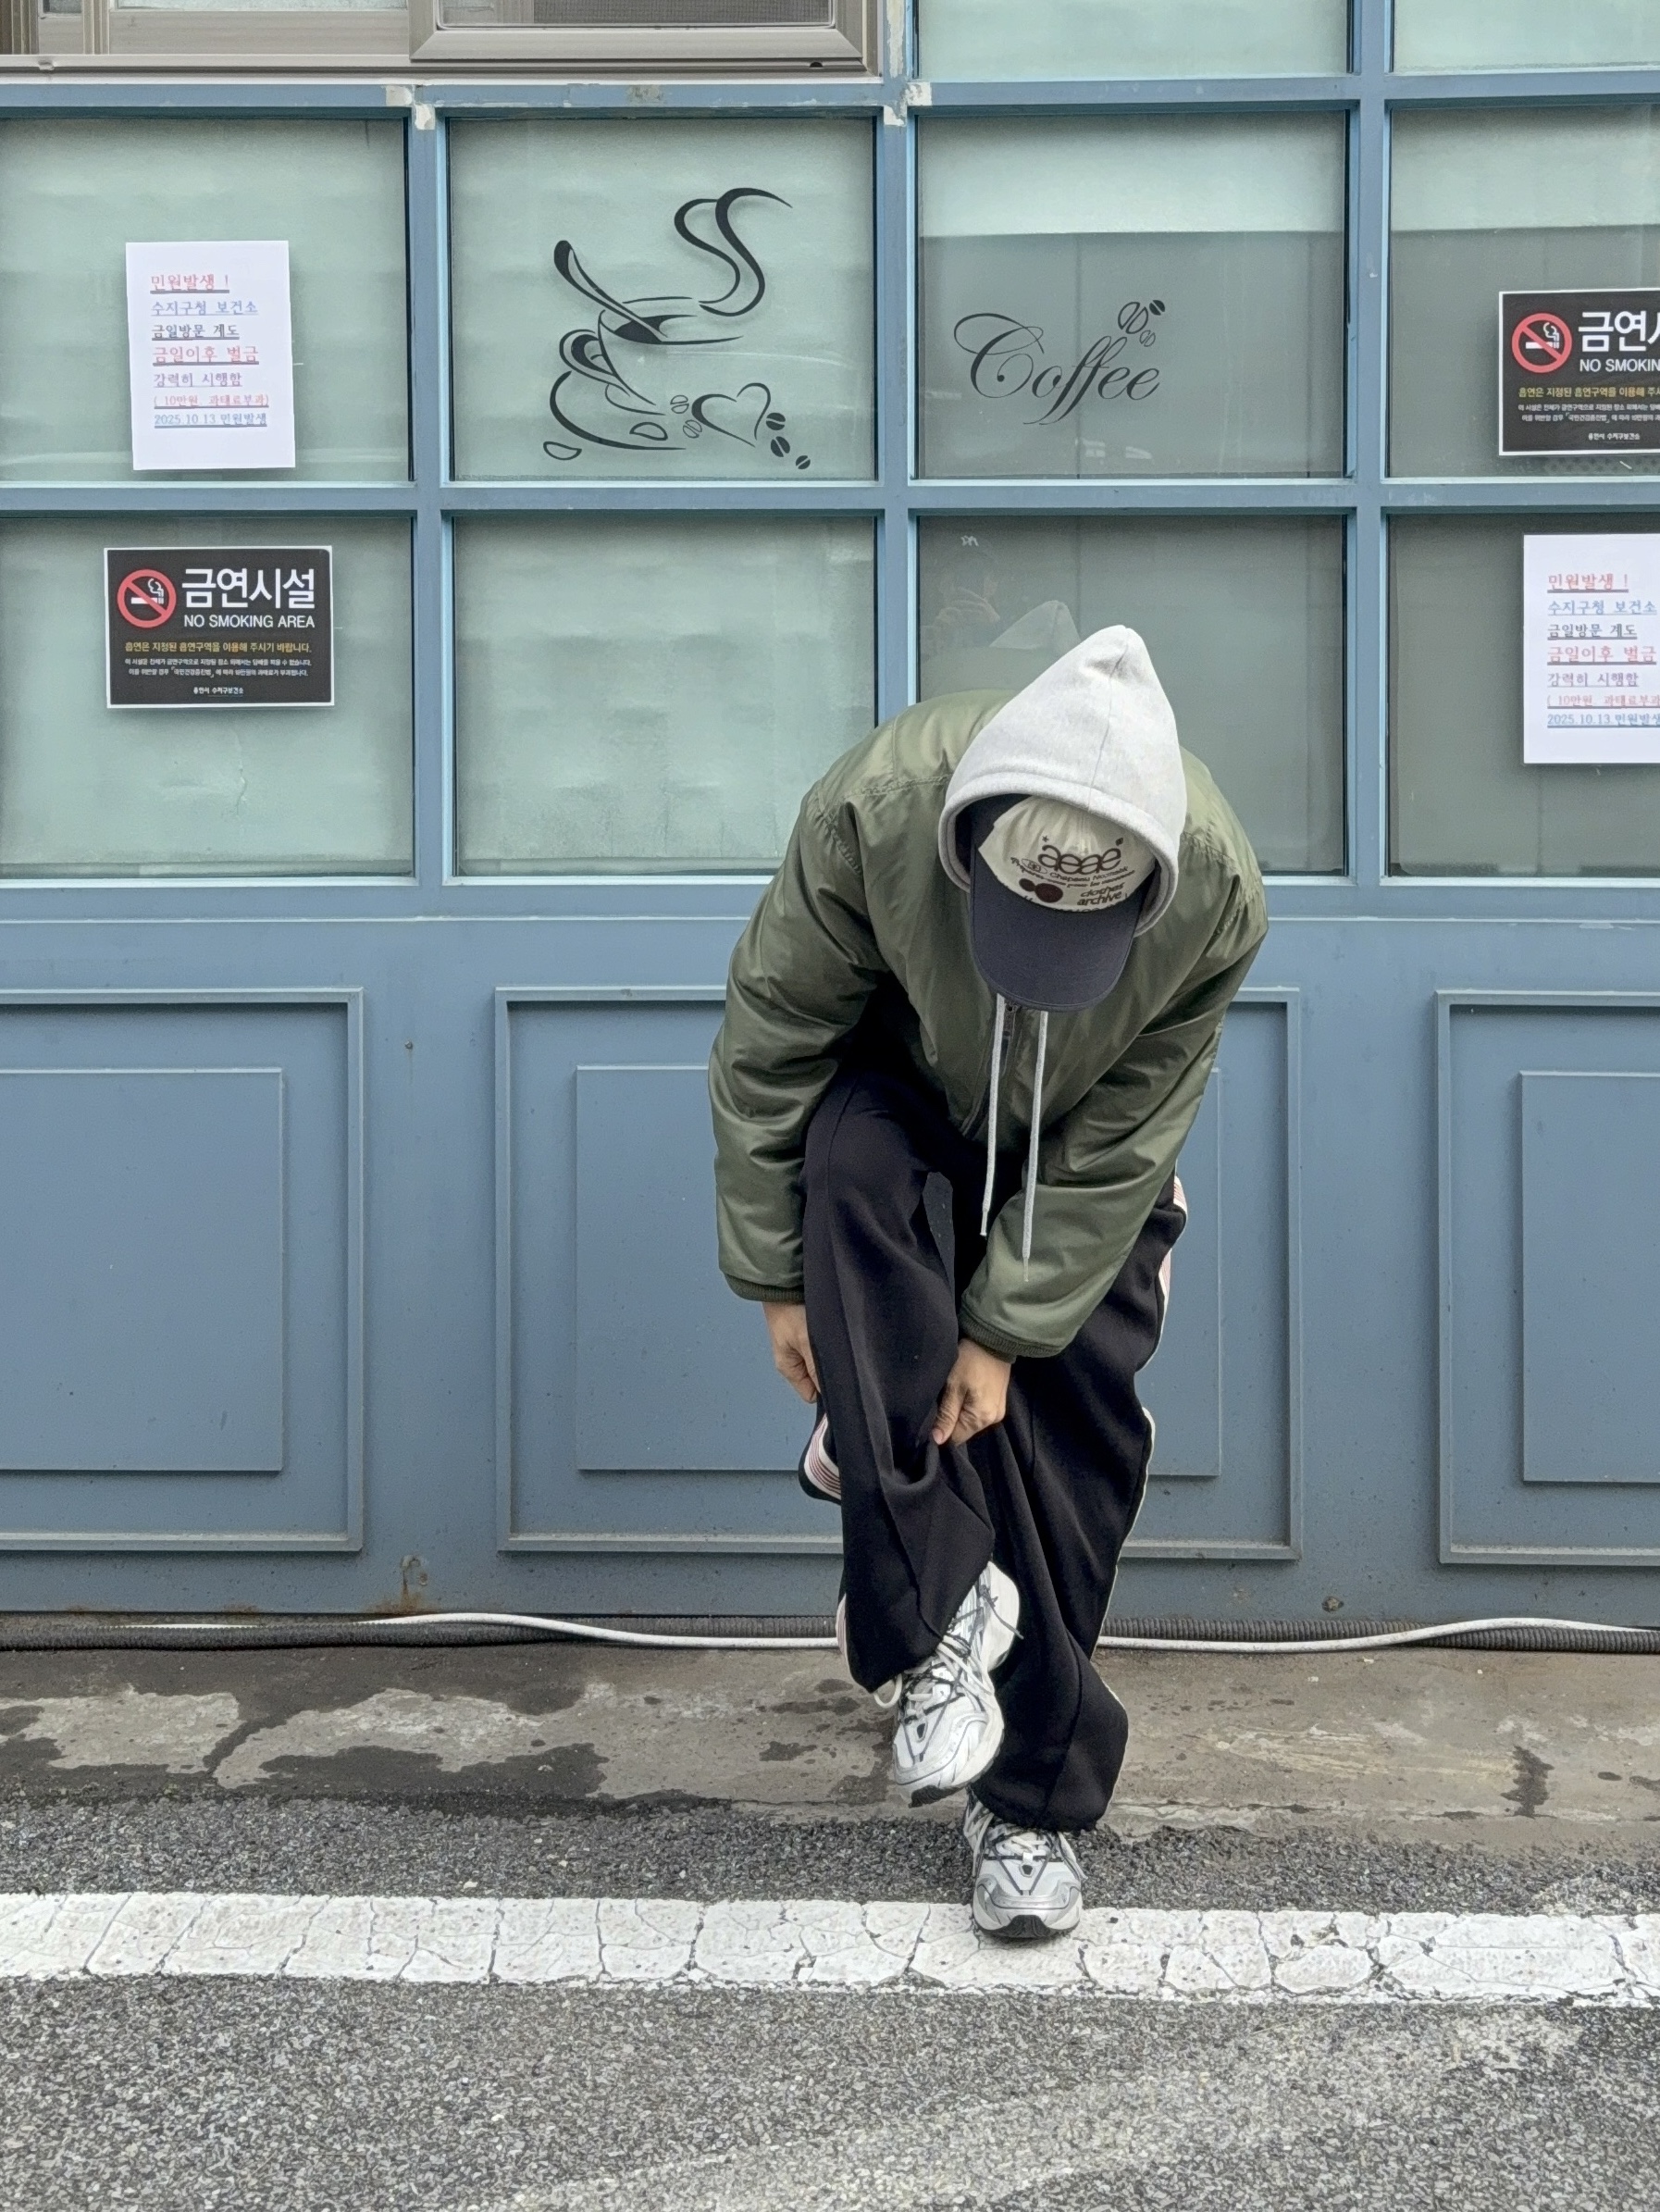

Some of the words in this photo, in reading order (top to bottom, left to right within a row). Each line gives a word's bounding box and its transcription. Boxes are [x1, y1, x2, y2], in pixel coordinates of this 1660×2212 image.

[151, 274, 215, 292] 민원발생
[151, 301, 207, 316] 수지구청
[216, 301, 258, 315] 보건소
[152, 325, 206, 339] 금일방문
[214, 324, 240, 337] 계도
[154, 346, 217, 363] 금일이후
[227, 345, 259, 362] 벌금
[954, 313, 1160, 425] Coffee
[1579, 359, 1601, 371] NO
[154, 373, 193, 387] 강력히
[202, 373, 242, 386] 시행함
[1518, 387, 1543, 398] 흡연은
[1546, 387, 1572, 398] 지정된
[1575, 387, 1617, 398] 흡연구역을
[1619, 387, 1644, 398] 이용해
[181, 568, 316, 609] 금연시설
[1548, 574, 1614, 590] 민원발생
[1548, 601, 1604, 615] 수지구청
[1615, 601, 1657, 615] 보건소
[184, 615, 205, 628] NO
[209, 615, 273, 628] SMOKING
[278, 615, 316, 628] AREA
[1548, 624, 1603, 638] 금일방문
[1610, 624, 1637, 637] 계도
[125, 642, 150, 652] 흡연은
[153, 642, 178, 652] 지정된
[180, 642, 220, 652] 흡연구역을
[223, 642, 248, 652] 이용해
[250, 642, 275, 652] 주시기
[1548, 646, 1614, 663] 금일이후
[1624, 646, 1656, 663] 벌금
[1548, 673, 1589, 687] 강력히
[1597, 673, 1639, 687] 시행함
[1077, 891, 1122, 906] archive
